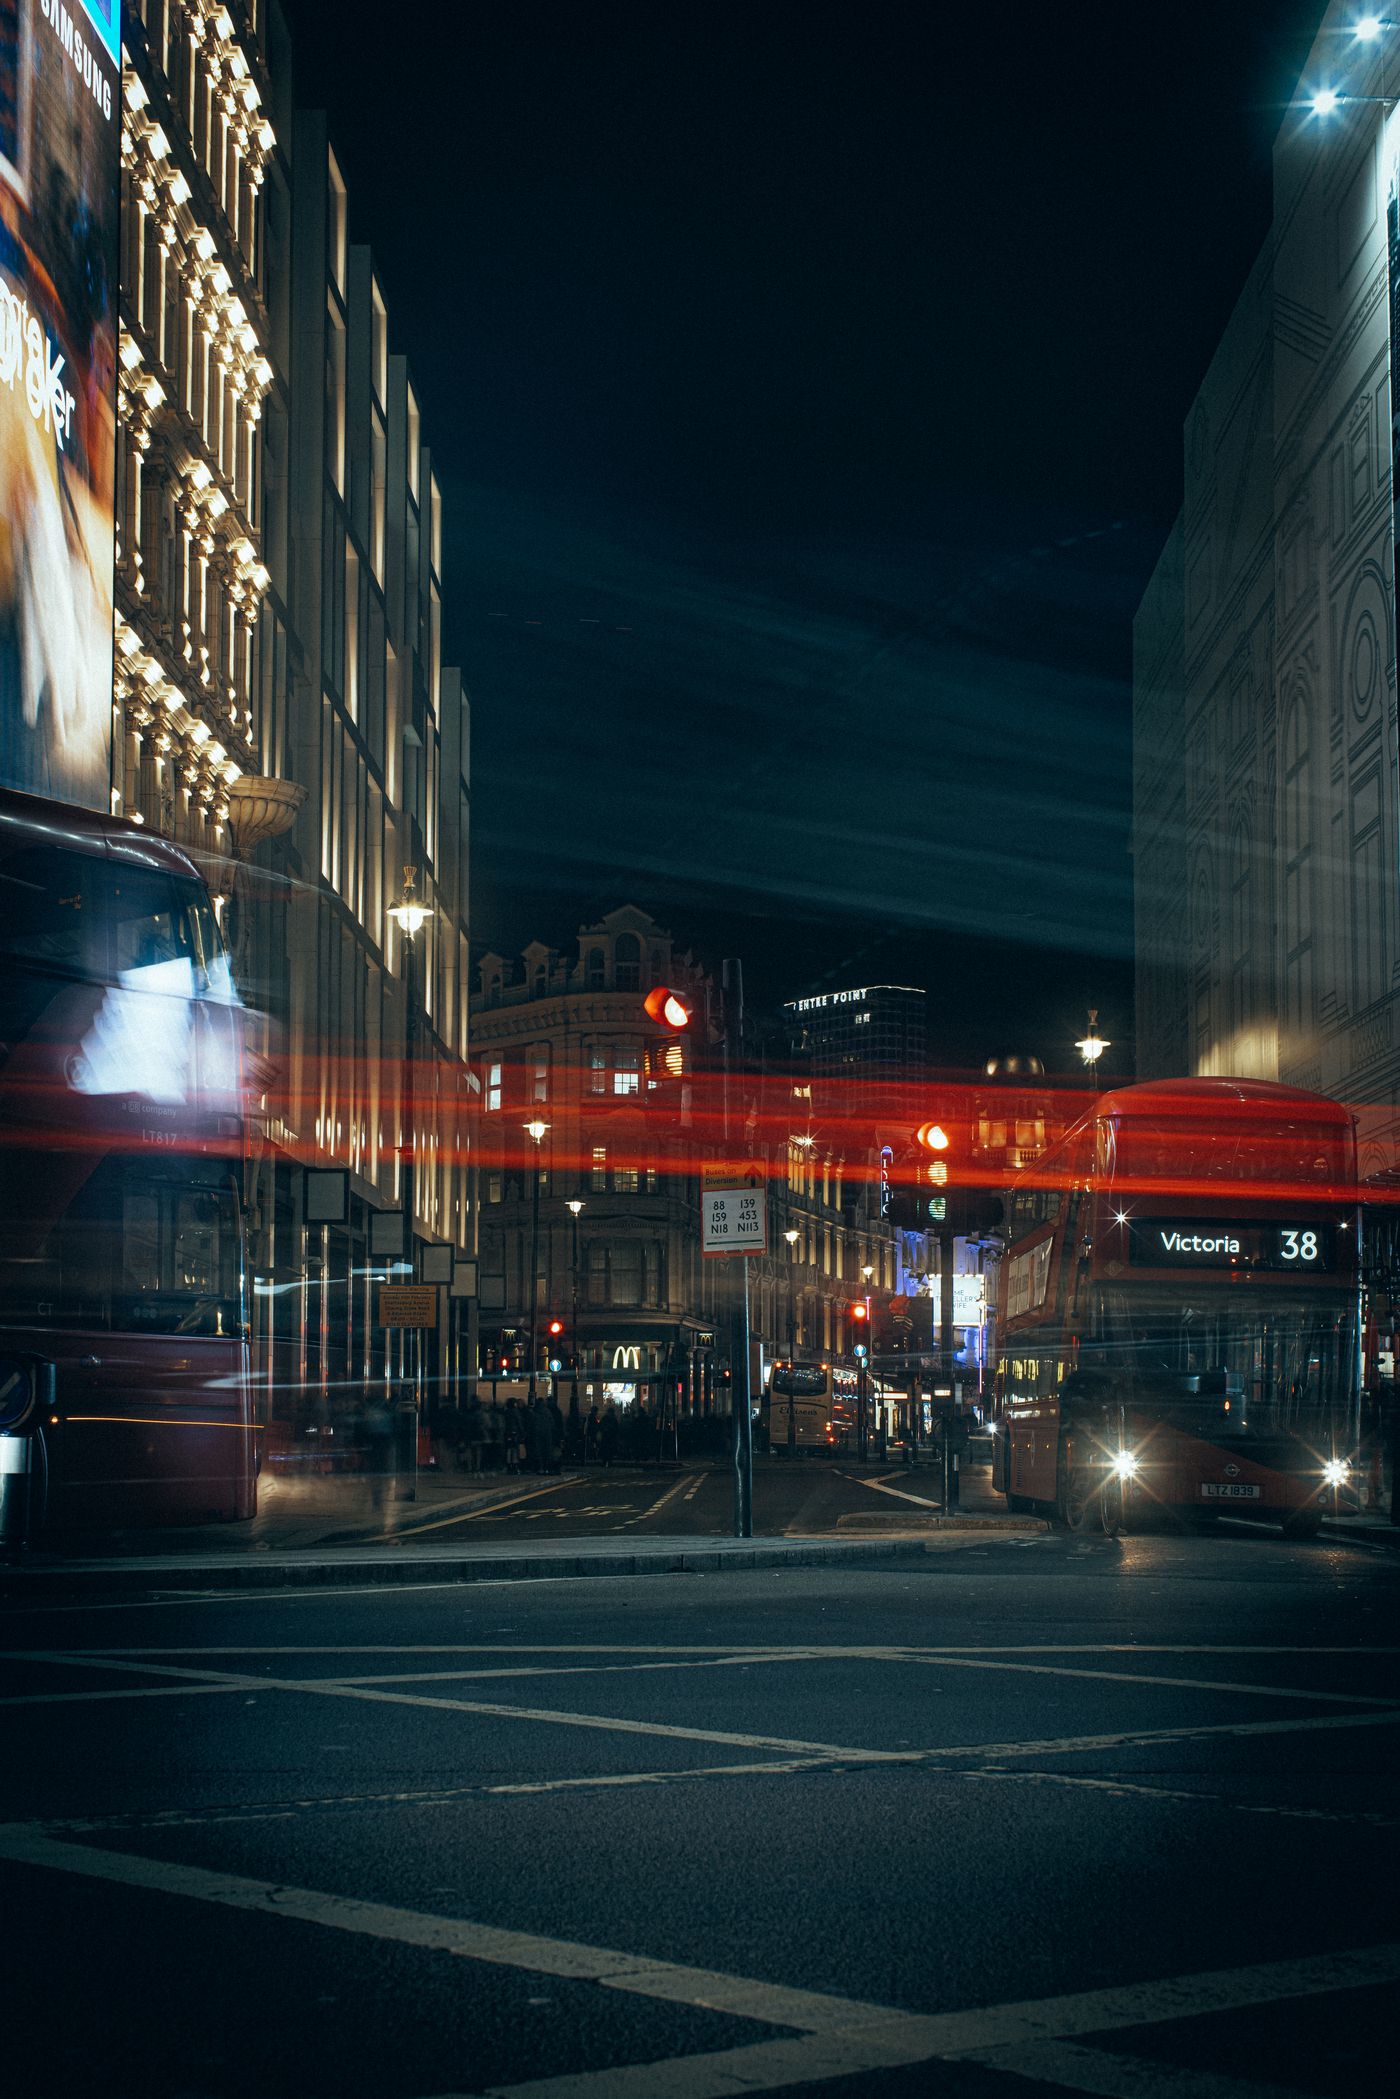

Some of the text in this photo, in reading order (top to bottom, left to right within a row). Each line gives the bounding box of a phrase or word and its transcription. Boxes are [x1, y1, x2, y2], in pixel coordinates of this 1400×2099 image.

[833, 989, 867, 1003] POINT
[141, 1104, 177, 1119] company
[142, 1128, 177, 1146] LT817
[705, 1168, 725, 1176] Buses
[705, 1177, 738, 1185] Diversion
[713, 1198, 756, 1211] 88 139
[712, 1210, 757, 1223] 159 453
[711, 1221, 759, 1234] N18 N113
[1160, 1230, 1318, 1261] Victoria 38
[936, 1295, 978, 1303] TELLER'S
[1207, 1485, 1254, 1496] LTZ 1839
